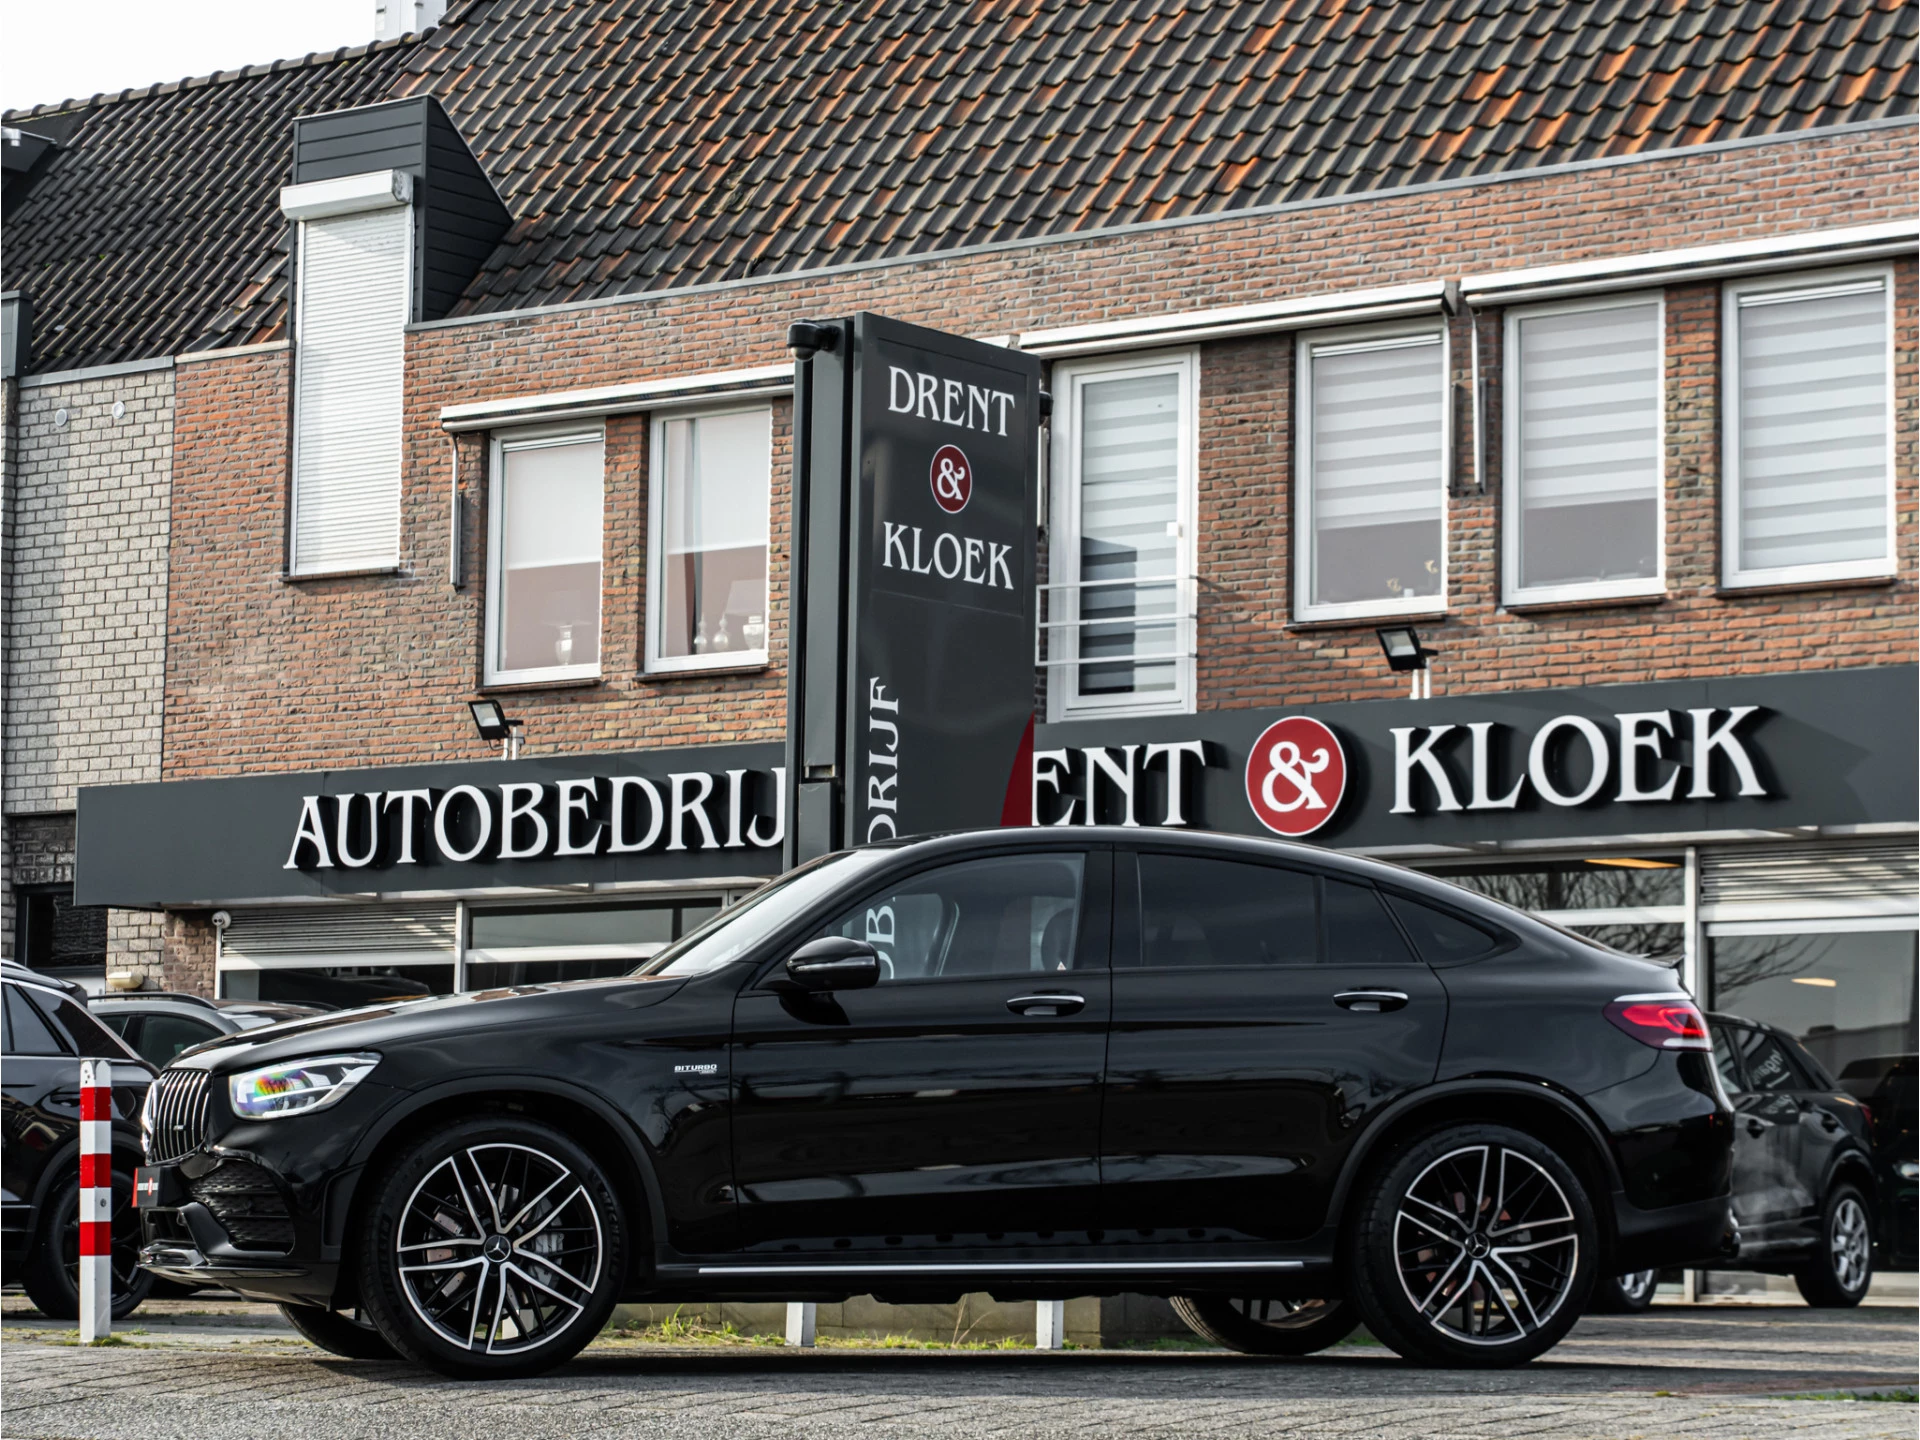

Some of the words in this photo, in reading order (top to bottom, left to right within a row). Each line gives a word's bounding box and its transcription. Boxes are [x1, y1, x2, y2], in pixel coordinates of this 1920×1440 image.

[888, 366, 1015, 437] DRENT
[937, 458, 965, 500] &
[882, 521, 1014, 590] KLOEK
[283, 767, 785, 869] AUTOBEDRIJ
[1032, 740, 1206, 827] ENT
[1261, 740, 1329, 813] &
[1389, 705, 1768, 814] KLOEK
